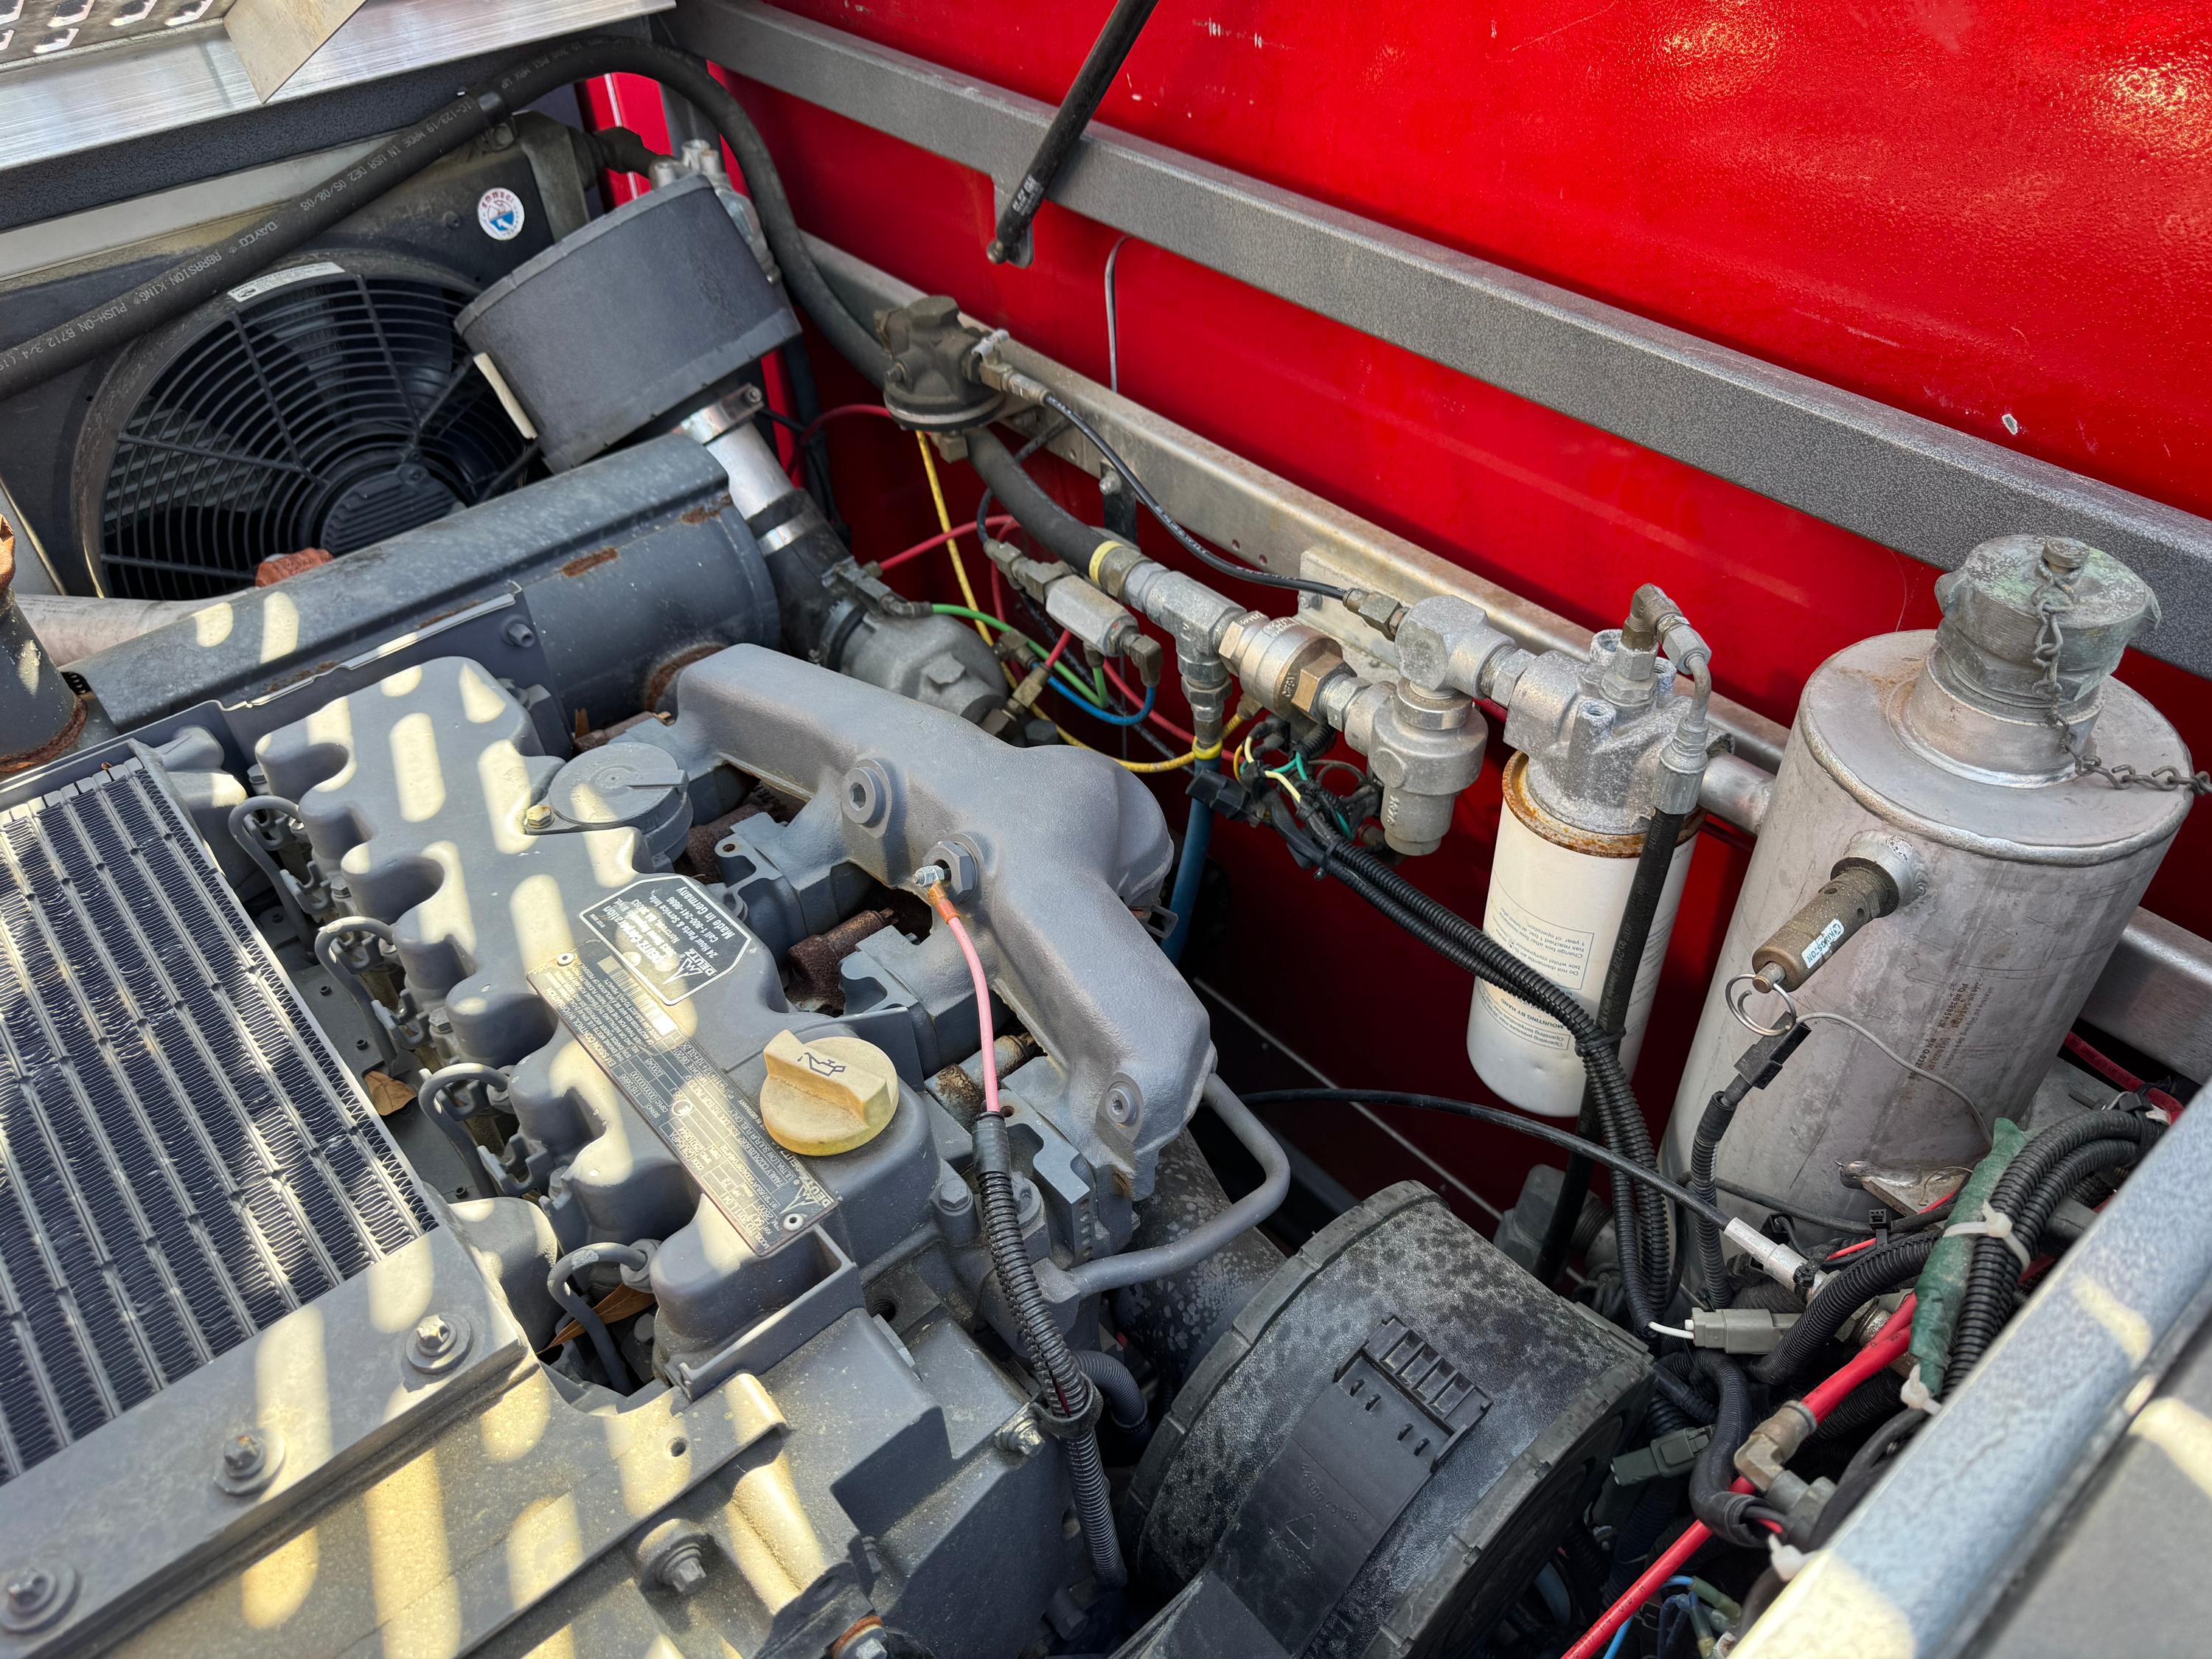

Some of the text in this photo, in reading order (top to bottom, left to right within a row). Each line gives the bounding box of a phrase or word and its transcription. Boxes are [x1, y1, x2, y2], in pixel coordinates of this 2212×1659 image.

[424, 99, 472, 134] IC-123/19
[400, 127, 425, 149] MADE
[385, 143, 401, 159] IN
[366, 151, 388, 171] USA
[238, 220, 278, 248] DAYCO
[168, 250, 222, 285] ABRASION
[77, 301, 127, 333] PUSH-ON
[21, 341, 43, 360] 3/4
[613, 897, 630, 914] Blvd.
[675, 882, 735, 941] Made in Germany
[601, 902, 644, 944] Corporation
[646, 891, 717, 959] 24 Hour Parts & Service Info.
[666, 894, 719, 945] Call 1-800-241-9886
[1544, 937, 1571, 949] reached
[1564, 936, 1580, 945] year
[684, 945, 716, 977] DEUTZ
[1557, 947, 1582, 959] Change
[1526, 955, 1557, 971] dismantle
[618, 1006, 628, 1016] MAY
[1500, 997, 1516, 1012] HAND
[1517, 1009, 1526, 1017] BY
[611, 1010, 621, 1020] THE
[571, 1018, 596, 1043] CONTROL
[592, 1026, 606, 1040] MEETS
[1533, 1029, 1564, 1042] Operating
[1532, 1034, 1562, 1047] Operating
[619, 1071, 642, 1098] 11675886
[728, 1107, 743, 1123] ONLY
[737, 1097, 758, 1120] GERMANY
[740, 1119, 754, 1135] FUEL
[750, 1131, 770, 1153] SULFUR
[767, 1150, 781, 1164] LOW
[766, 1167, 785, 1187] FAMILY
[777, 1161, 794, 1180] ULTRA
[721, 1177, 732, 1188] 73
[723, 1193, 734, 1206] 04
[729, 1201, 738, 1210] L
[733, 1206, 750, 1225] 2011
[749, 1209, 765, 1226] 54,7
[757, 1203, 774, 1221] 2600
[745, 1220, 757, 1233] TD
